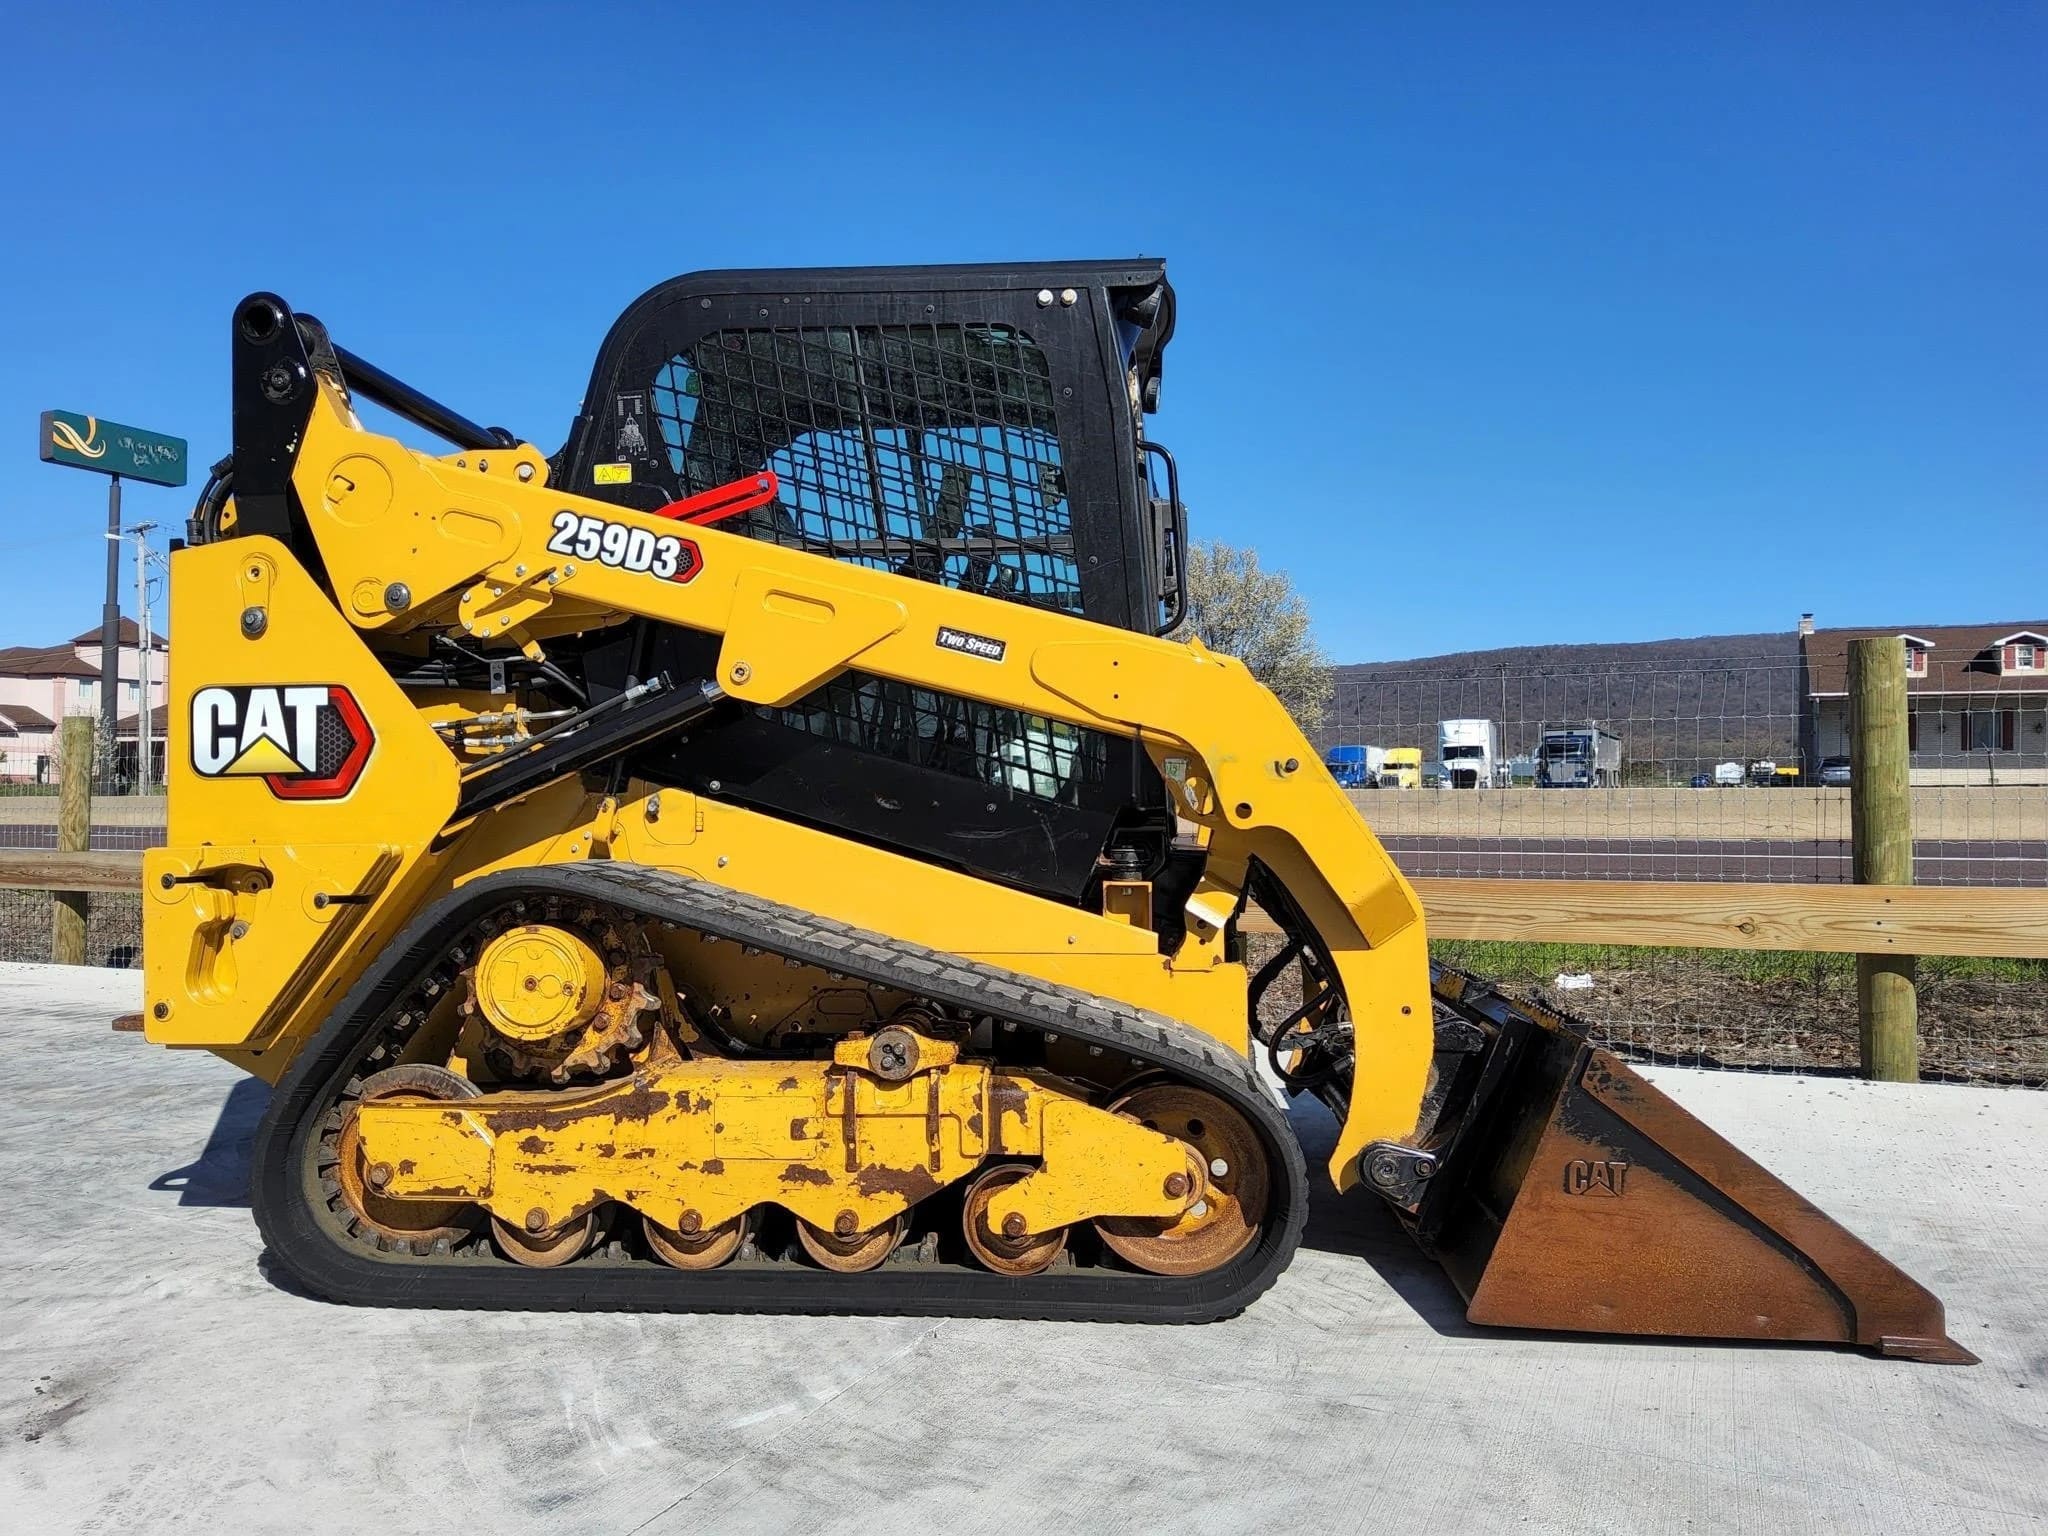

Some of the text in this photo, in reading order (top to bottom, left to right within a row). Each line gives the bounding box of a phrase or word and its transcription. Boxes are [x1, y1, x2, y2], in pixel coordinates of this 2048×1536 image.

[548, 511, 681, 578] 259D3
[192, 686, 329, 775] CAT
[1566, 1160, 1627, 1196] CAT
